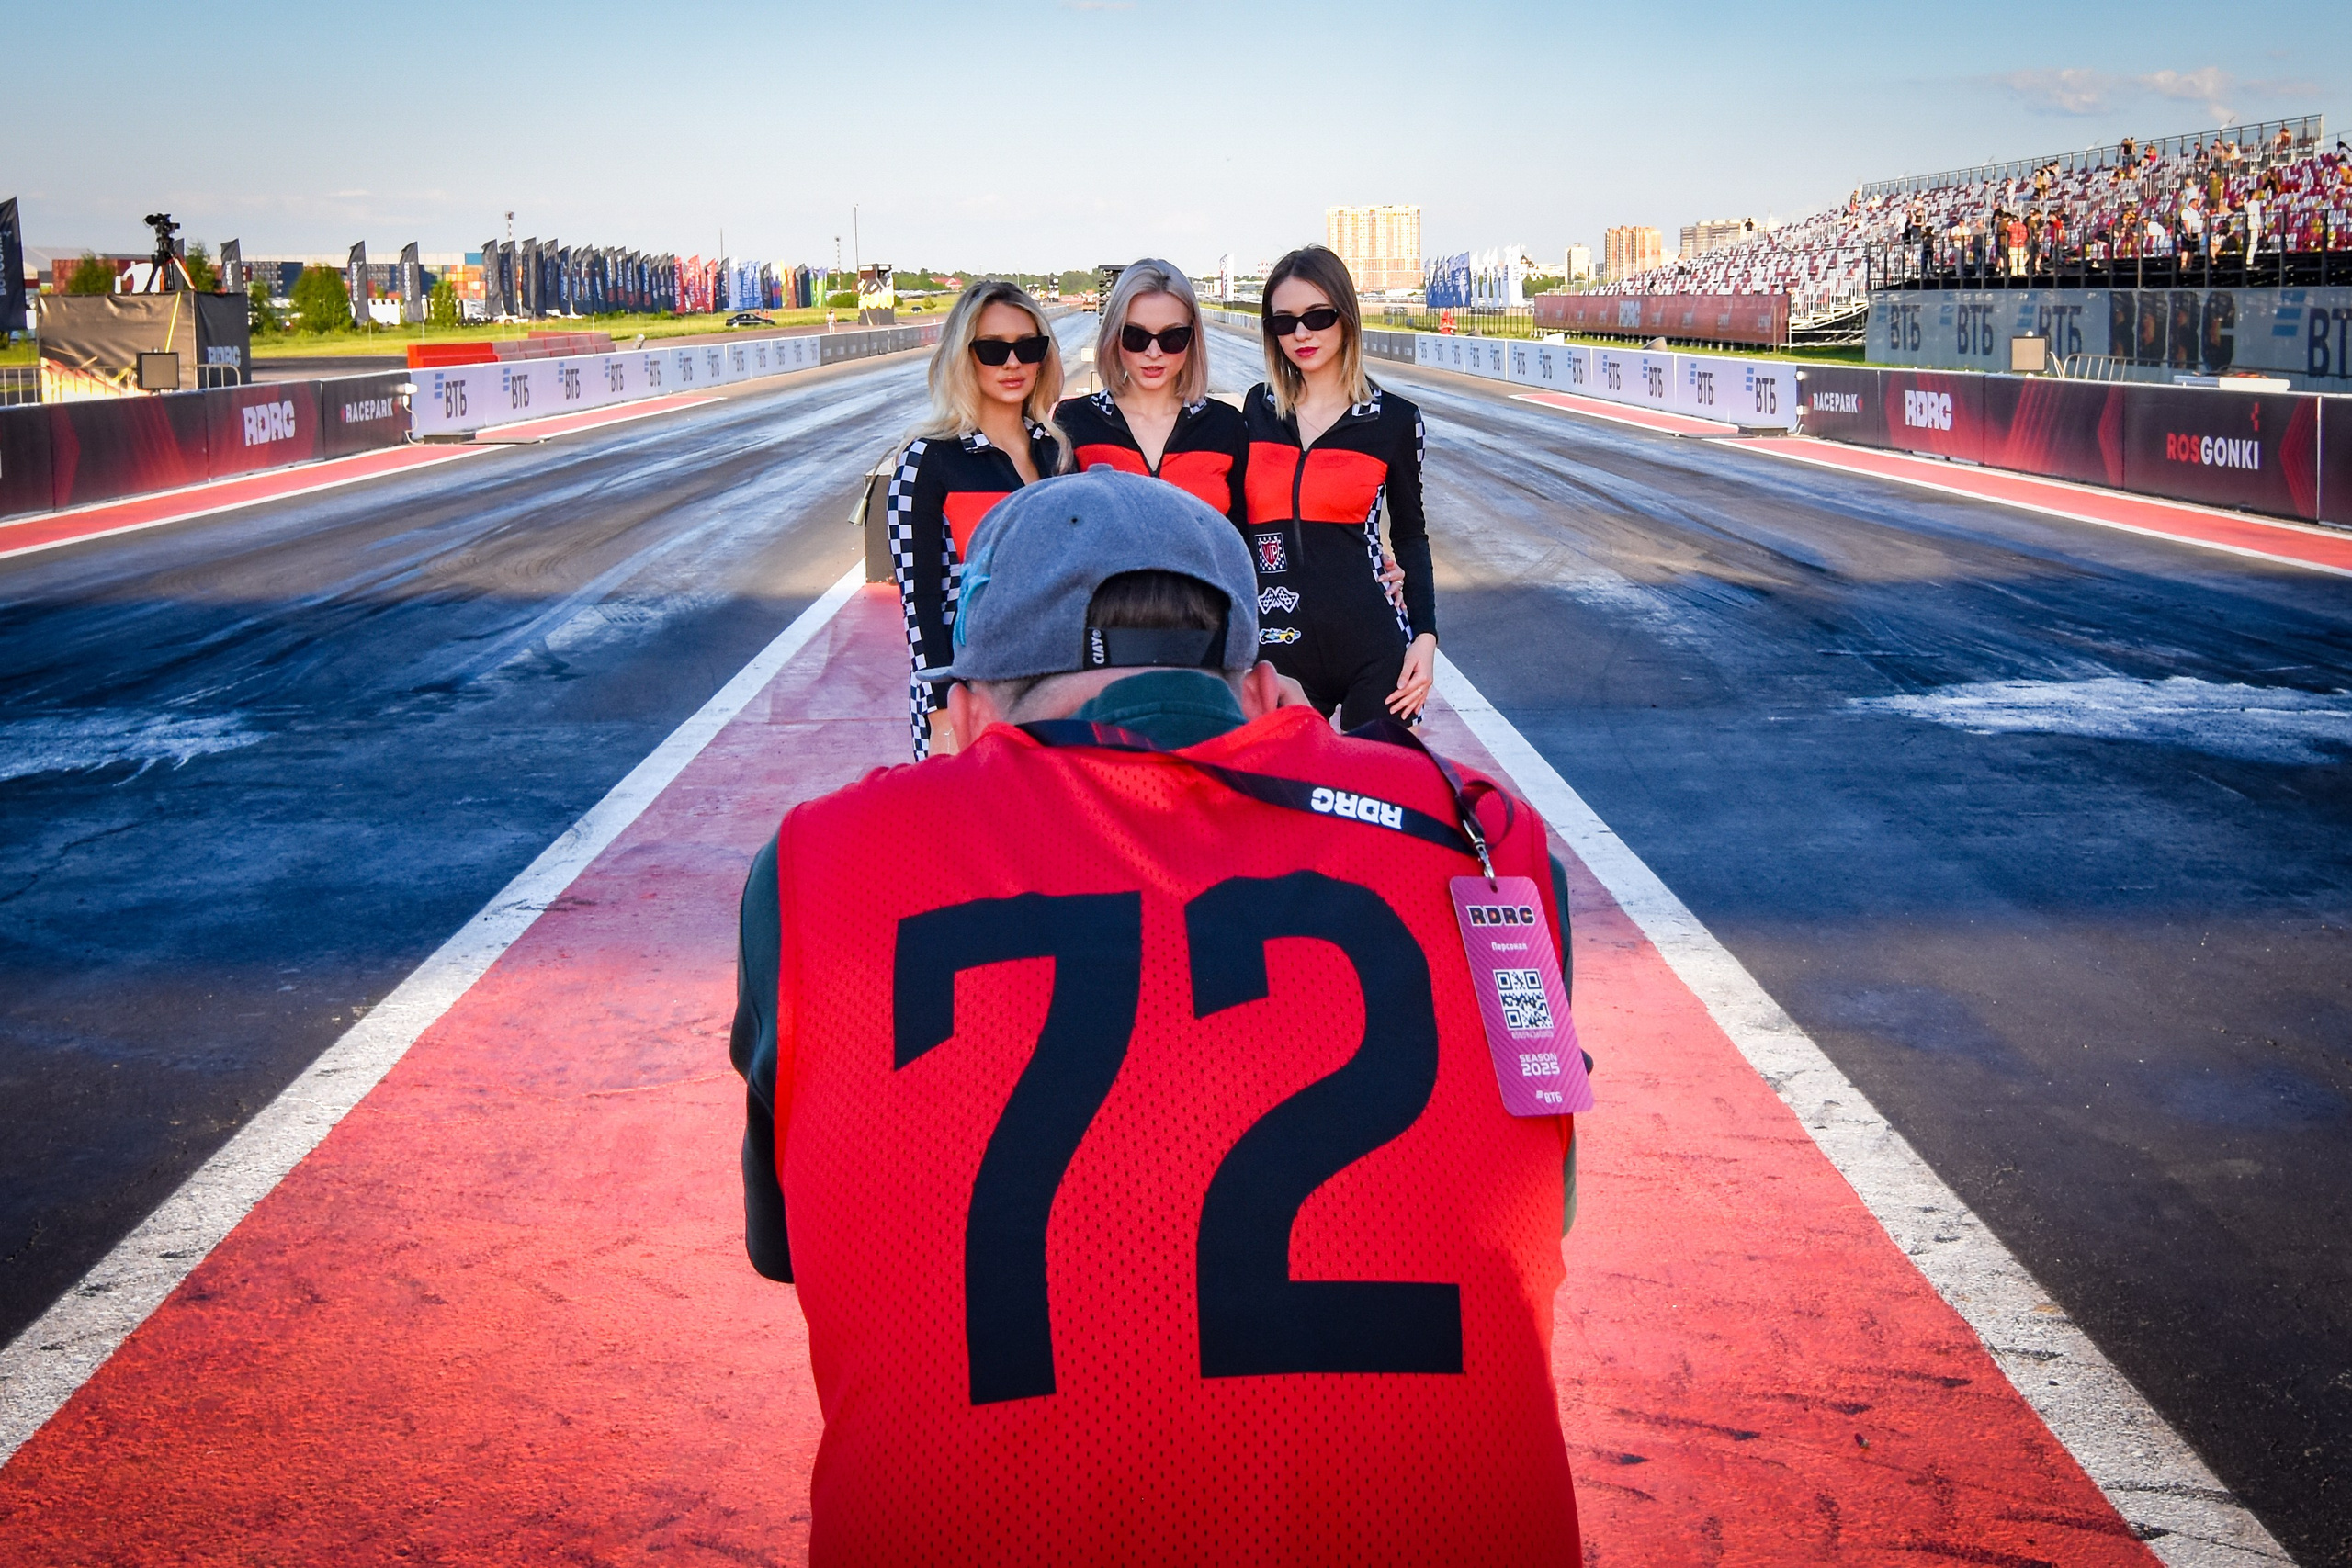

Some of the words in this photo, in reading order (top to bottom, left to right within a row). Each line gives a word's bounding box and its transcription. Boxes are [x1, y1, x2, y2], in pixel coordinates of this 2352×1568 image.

[1890, 304, 1921, 352] ВТБ
[1958, 304, 1994, 356] ВТБ
[2109, 291, 2234, 371] RDRC
[2307, 308, 2352, 378] ВТ
[511, 374, 530, 409] ВТБ
[565, 368, 581, 400] ВТБ
[610, 363, 624, 392] ВТБ
[1608, 362, 1621, 390] ВТБ
[1648, 367, 1664, 398] ВТБ
[1697, 371, 1714, 405] ВТБ
[345, 398, 394, 423] RACEPARK
[445, 379, 467, 419] ВТБ
[1755, 378, 1777, 414] ВТБ
[1813, 392, 1858, 413] RACEPARK
[1905, 389, 1952, 431] RDRC
[243, 400, 296, 446] RDRC
[2166, 433, 2259, 470] ROSGONKI
[1262, 545, 1278, 560] VIP
[1311, 786, 1403, 830] RDRC
[1465, 905, 1536, 927] RDRC
[1491, 942, 1528, 953] Персонал
[1519, 1053, 1558, 1063] SEASON
[1521, 1062, 1561, 1077] 2025
[1544, 1091, 1563, 1104] ВТБ
[894, 869, 1464, 1405] 72
